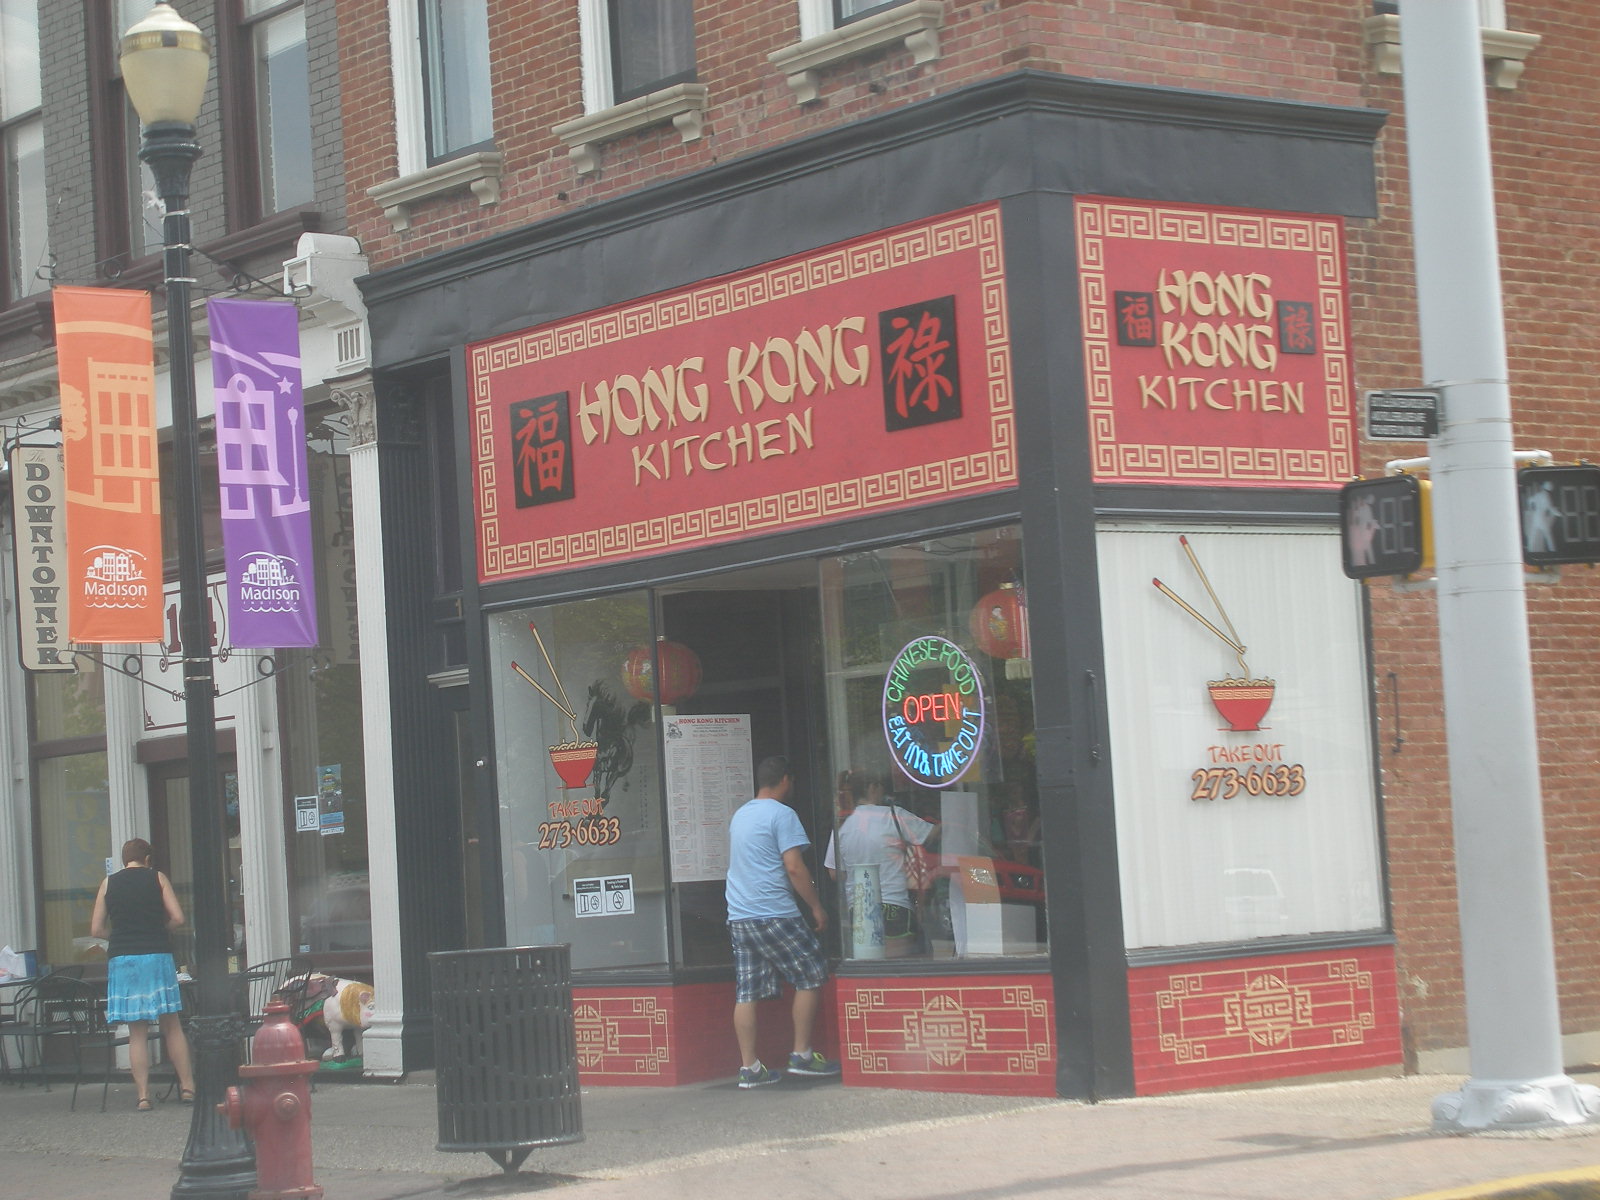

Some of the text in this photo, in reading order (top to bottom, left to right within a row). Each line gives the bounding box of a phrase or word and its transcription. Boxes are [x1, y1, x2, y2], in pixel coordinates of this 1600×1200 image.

[1121, 295, 1152, 340] 福
[1156, 268, 1273, 322] HONG
[1160, 320, 1277, 373] KONG
[577, 316, 871, 446] HONG KONG
[1138, 375, 1305, 414] KITCHEN
[515, 401, 566, 497] 福
[631, 407, 814, 486] KITCHEN
[24, 463, 60, 665] DOWNTOWNER
[84, 581, 148, 597] Madison
[241, 586, 300, 601] Madison
[886, 639, 976, 702] CHINESE FOOD
[903, 692, 961, 725] OPEN
[888, 715, 913, 749] EAT
[931, 742, 969, 777] TAKE
[958, 706, 982, 751] OUT
[1207, 743, 1287, 763] TAKE OUT
[1191, 764, 1307, 801] 273-6633
[548, 797, 606, 820] TAKE OUT
[538, 816, 621, 851] 273-6633
